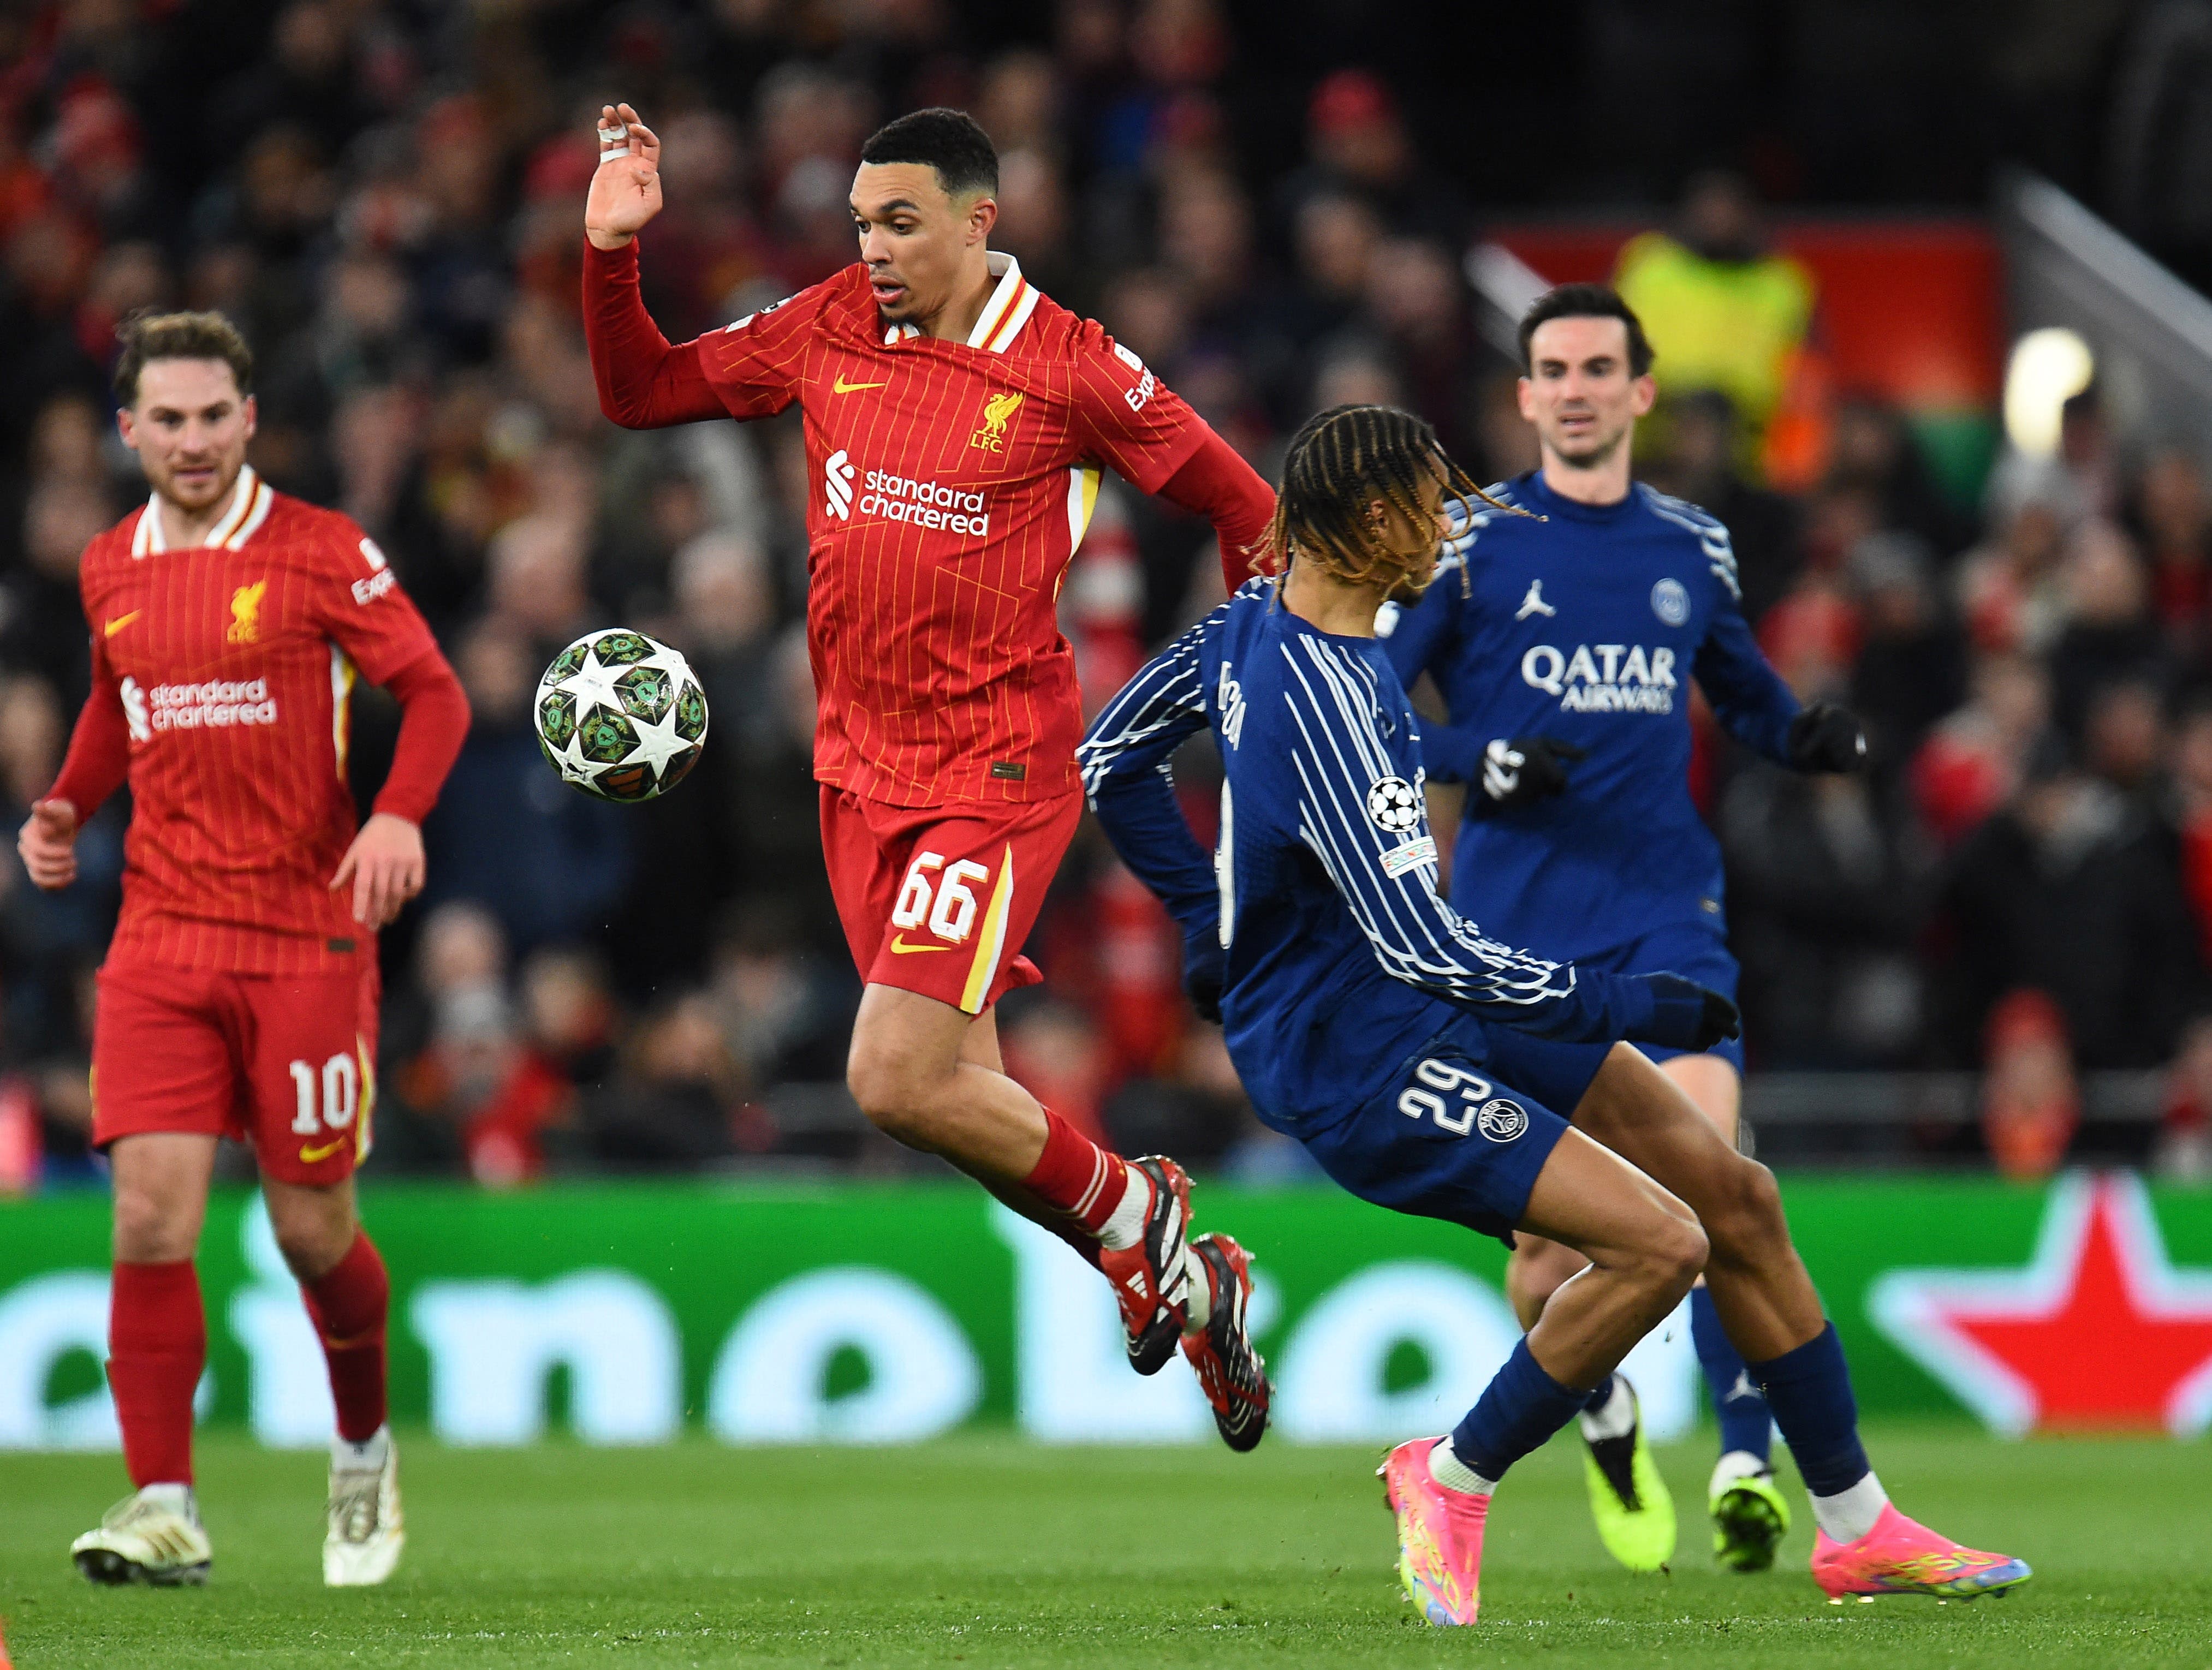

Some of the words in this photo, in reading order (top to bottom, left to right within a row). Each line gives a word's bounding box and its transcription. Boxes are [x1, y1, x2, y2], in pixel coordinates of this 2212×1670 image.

[865, 468, 984, 512] standard
[859, 493, 989, 536] chartered
[150, 677, 267, 709] standard
[1521, 643, 1677, 696] QATAR
[152, 698, 277, 731] chartered
[891, 851, 989, 944] 66
[289, 1052, 356, 1135] 10
[1398, 1058, 1493, 1136] 29
